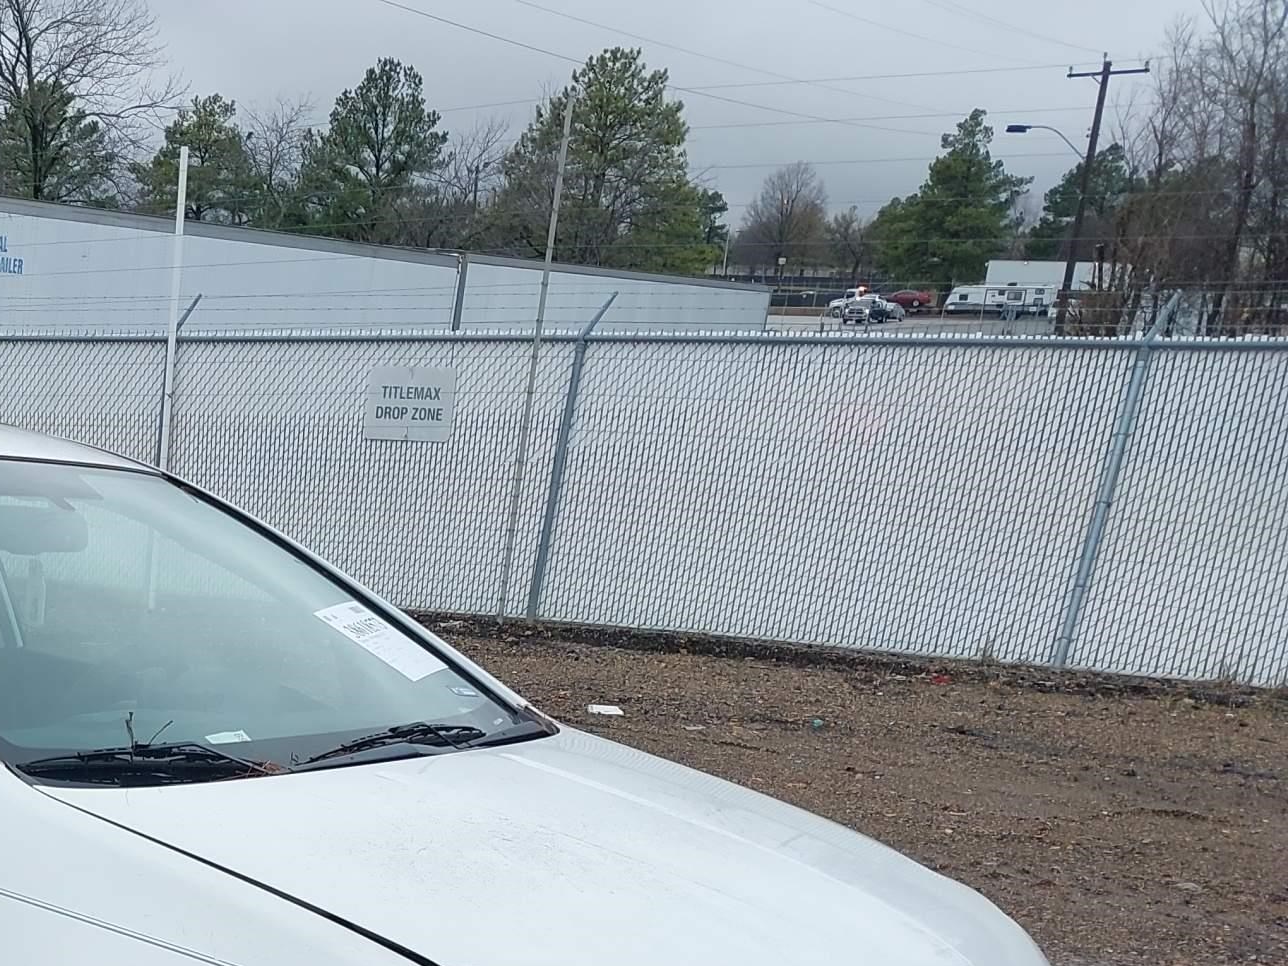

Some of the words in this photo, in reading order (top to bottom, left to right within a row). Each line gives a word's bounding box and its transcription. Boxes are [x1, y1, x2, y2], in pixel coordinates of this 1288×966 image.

[381, 385, 441, 401] TITLEMAX
[375, 405, 409, 420] DROP
[411, 407, 444, 422] ZONE
